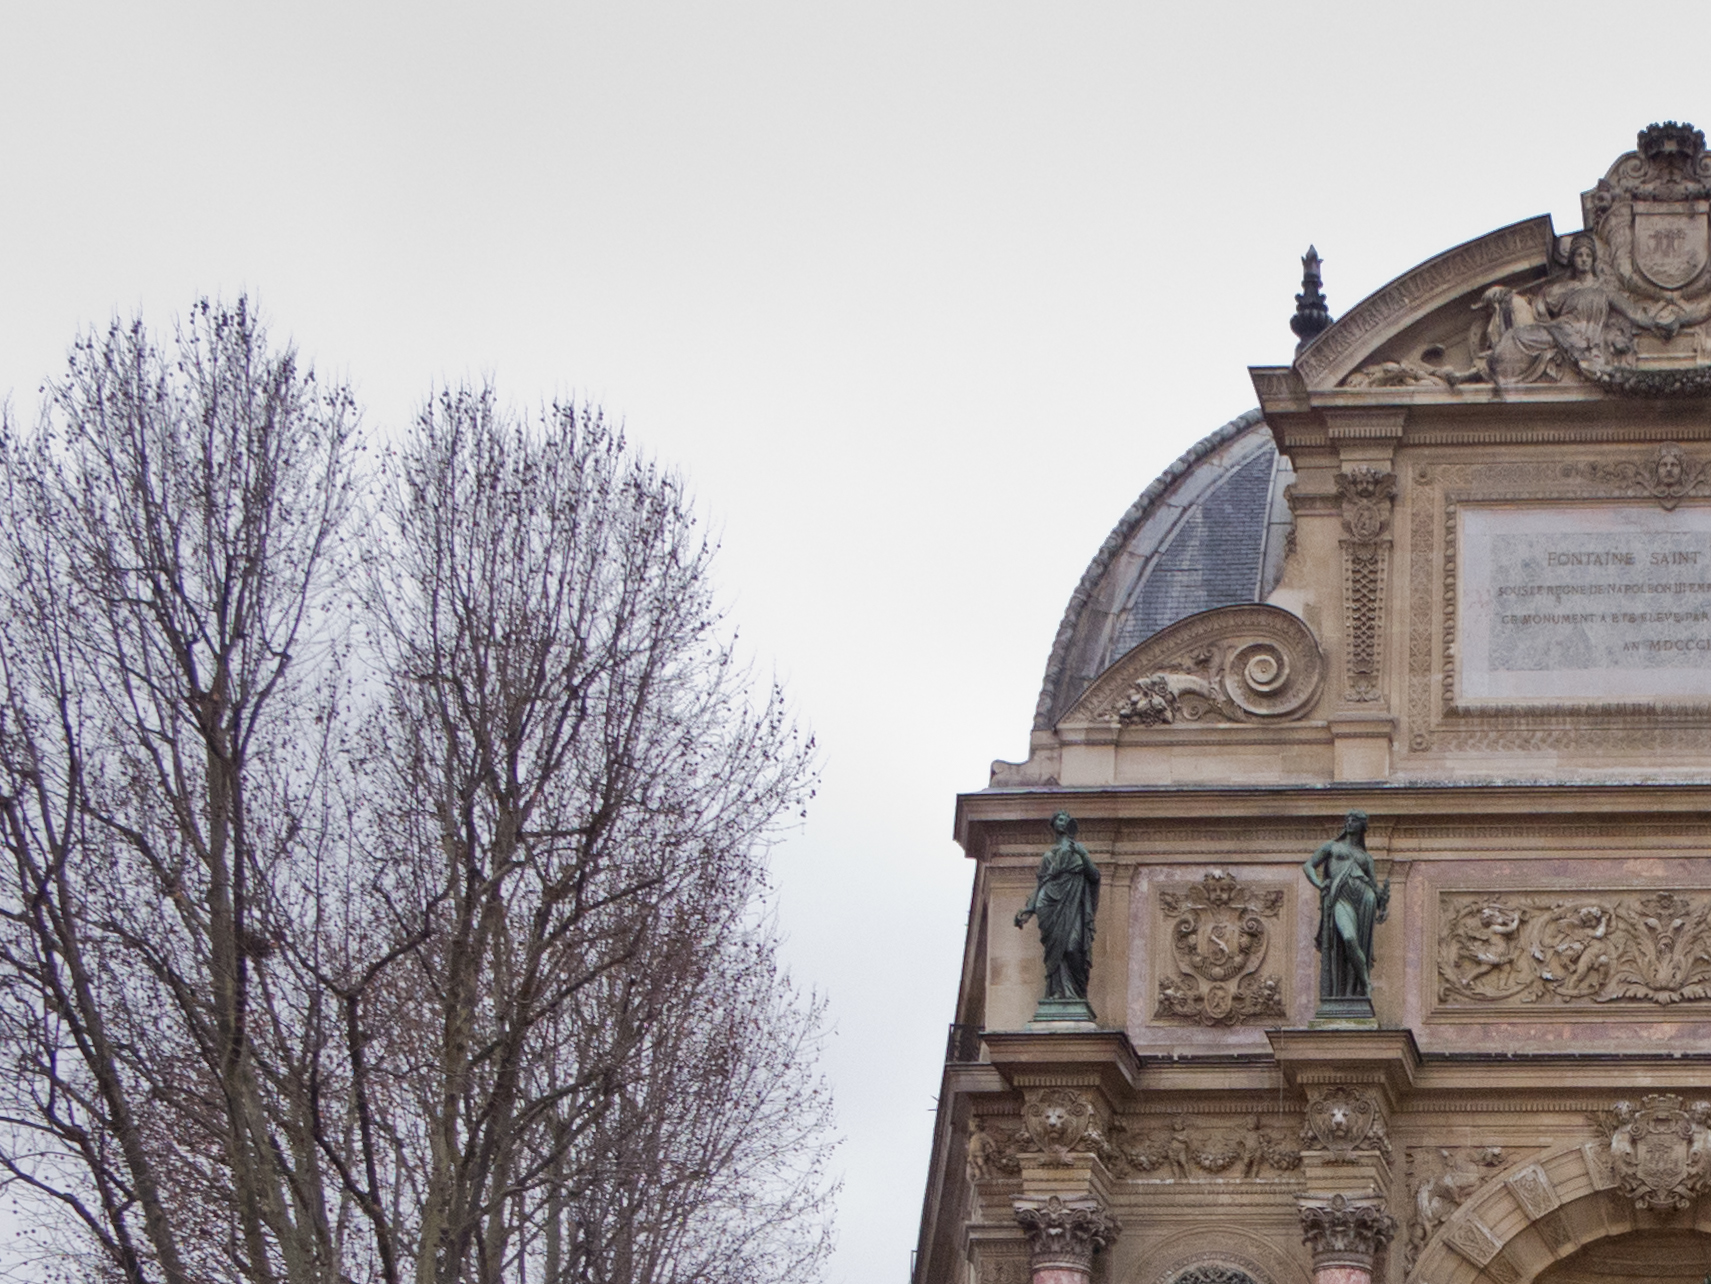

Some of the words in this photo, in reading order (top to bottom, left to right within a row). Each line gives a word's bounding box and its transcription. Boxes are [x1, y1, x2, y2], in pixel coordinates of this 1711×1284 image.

[1547, 551, 1636, 567] FONTAINE
[1650, 551, 1702, 566] SAINT
[1497, 585, 1526, 597] SOUS
[1589, 584, 1604, 595] DE
[1501, 614, 1518, 625] CE
[1520, 613, 1596, 625] MONUMENT
[1599, 613, 1608, 624] A
[1685, 611, 1709, 622] PAR
[1622, 641, 1640, 652] AN
